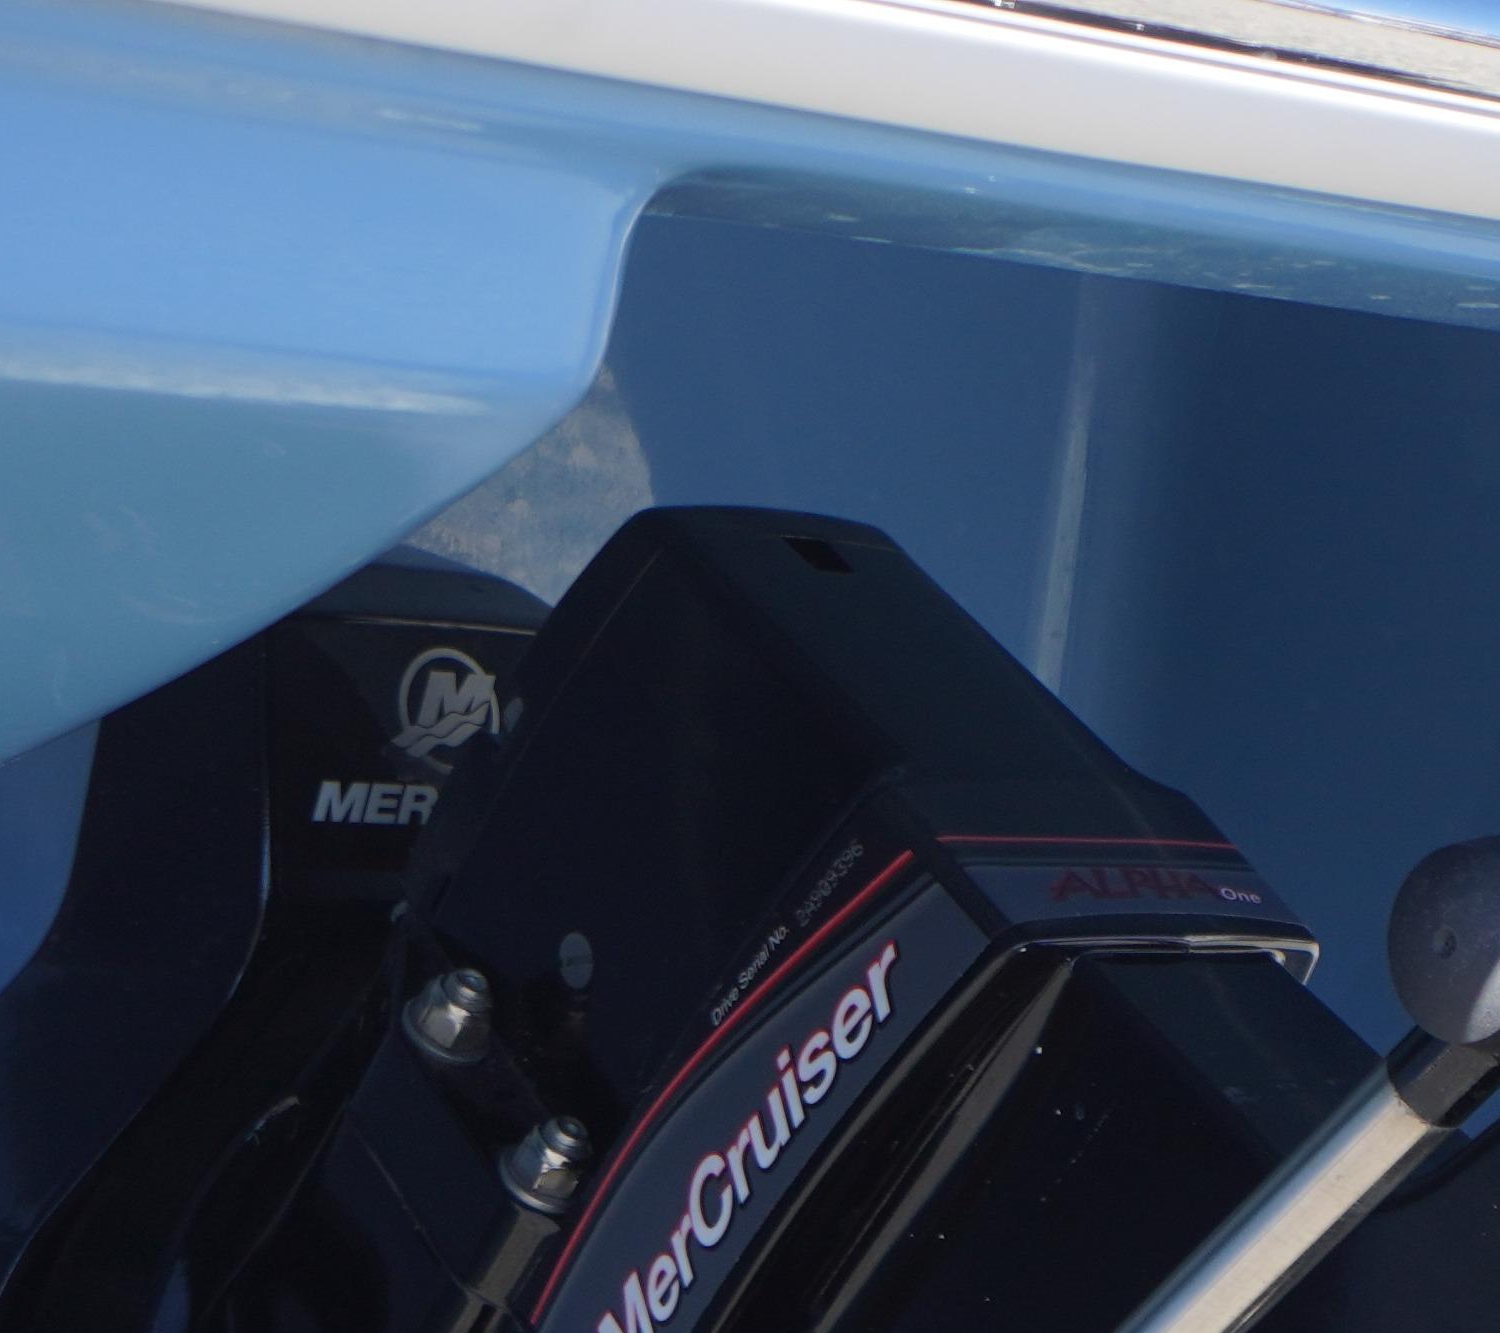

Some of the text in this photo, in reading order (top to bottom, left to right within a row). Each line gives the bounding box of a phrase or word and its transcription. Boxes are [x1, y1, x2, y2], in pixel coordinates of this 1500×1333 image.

[1047, 868, 1264, 905] ALPHA One
[710, 987, 739, 1026] Drive
[738, 945, 770, 989] Serial
